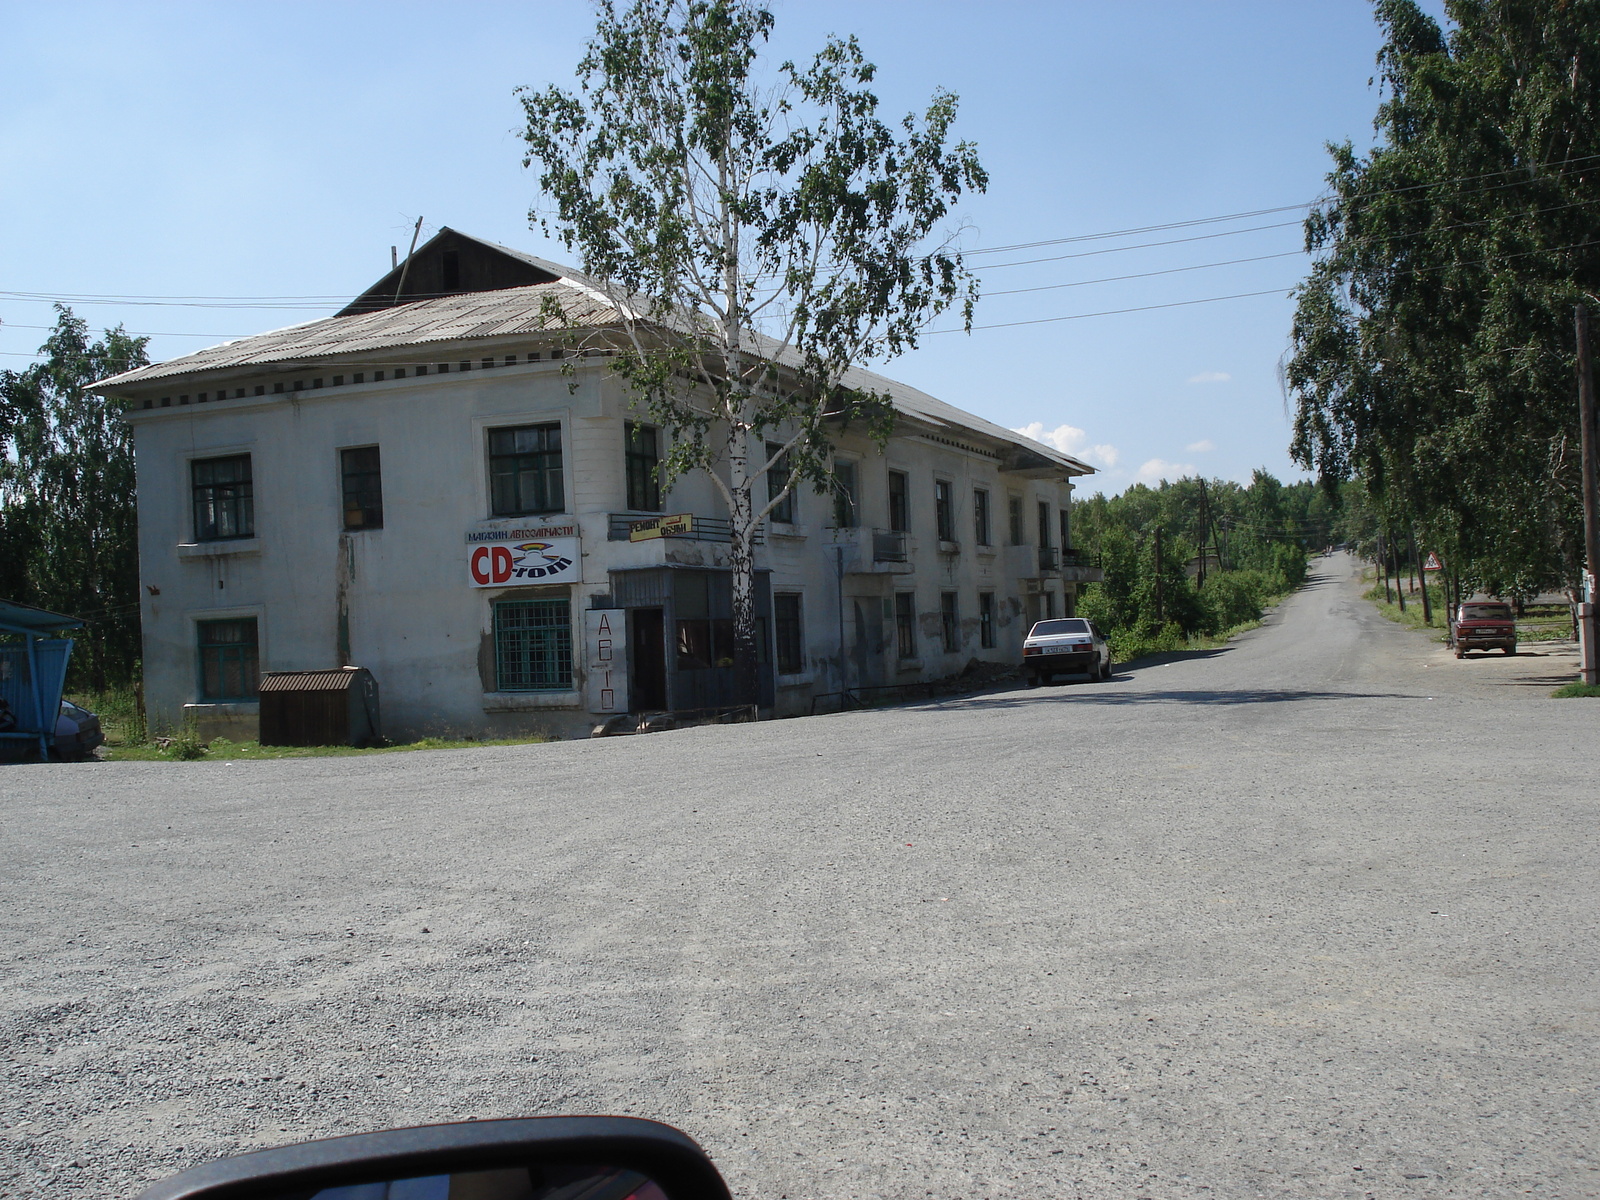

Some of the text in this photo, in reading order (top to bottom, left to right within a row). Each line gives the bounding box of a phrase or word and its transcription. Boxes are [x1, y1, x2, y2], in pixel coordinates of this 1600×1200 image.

[630, 519, 660, 533] РЕМОНТ
[660, 523, 687, 536] ОБУВИ
[468, 531, 508, 541] МАГАЗИН
